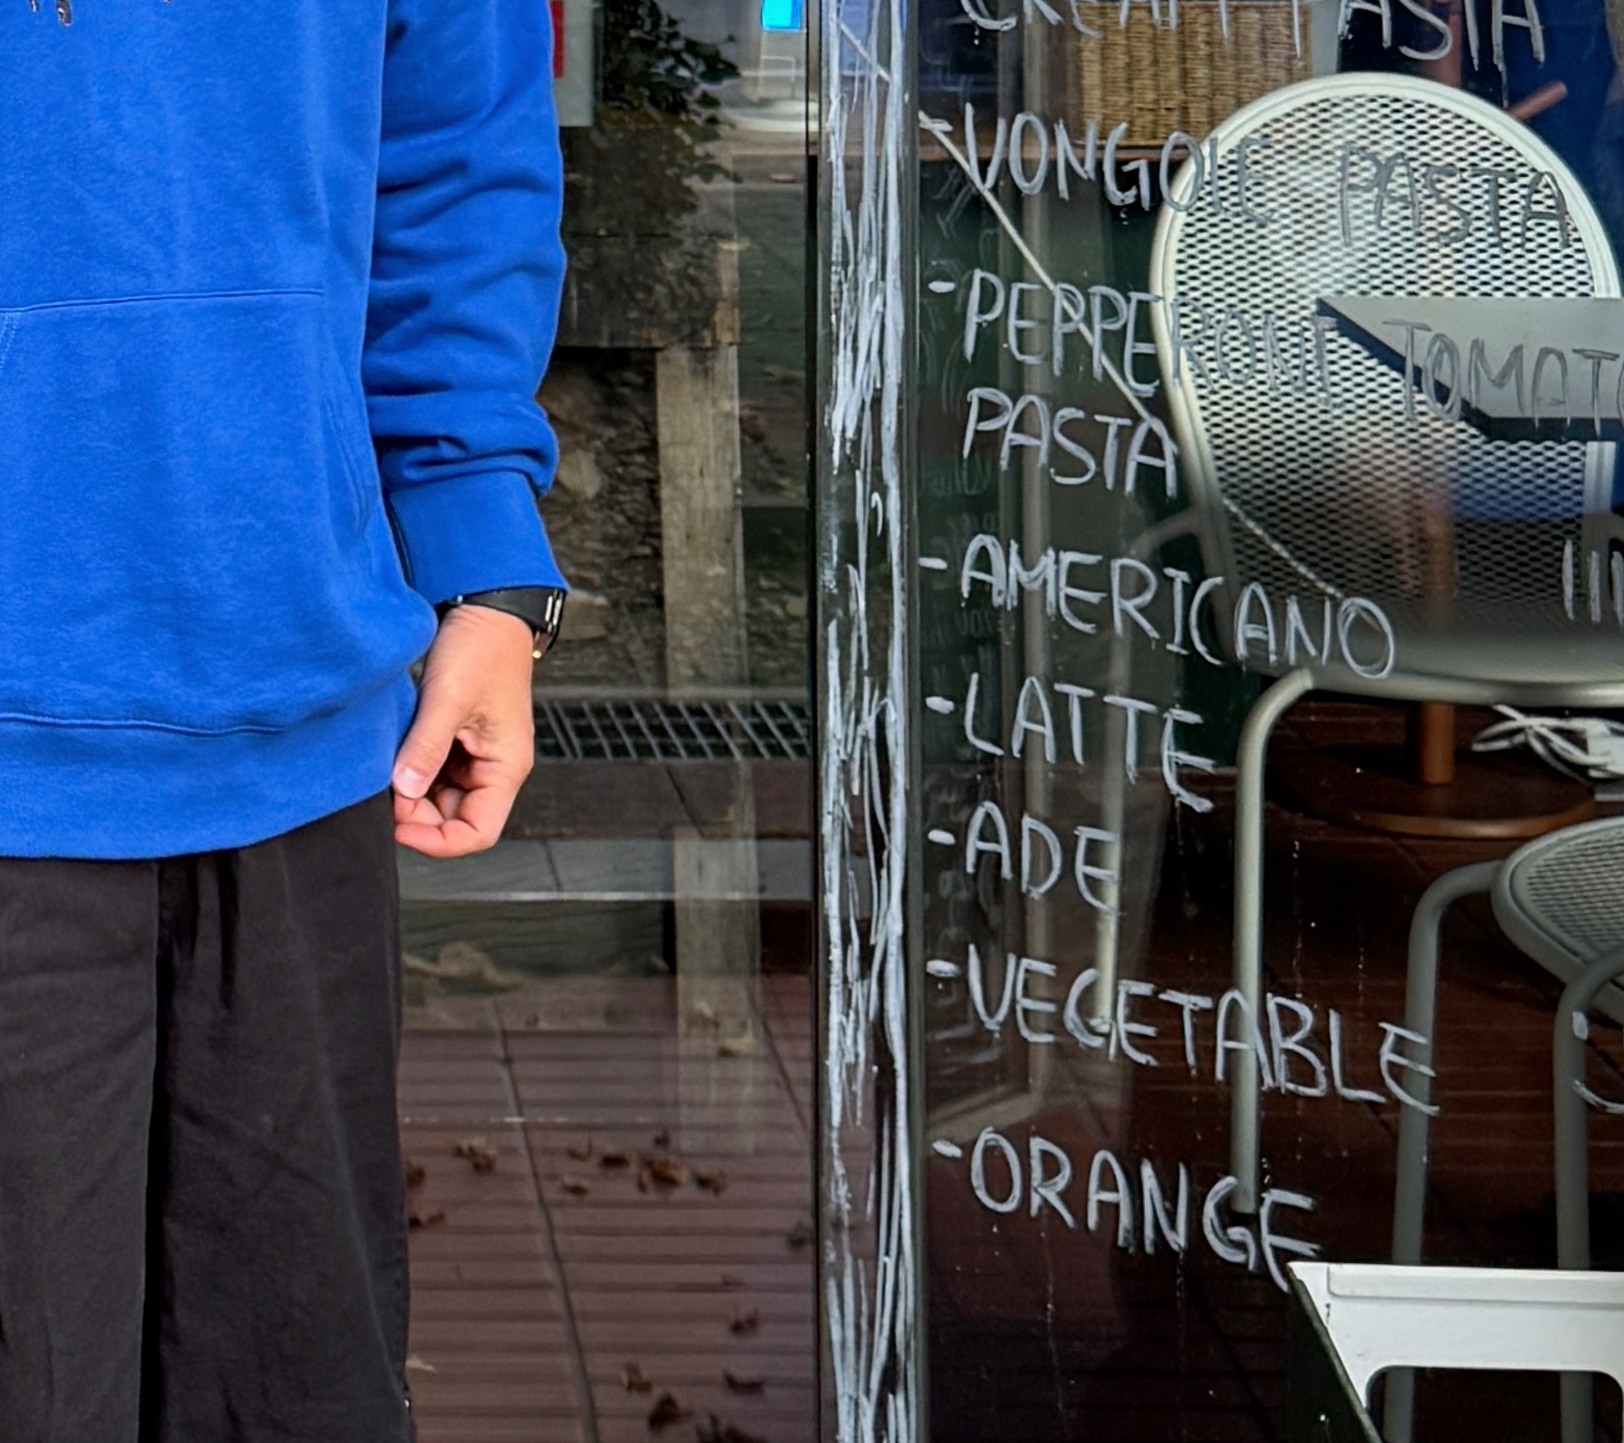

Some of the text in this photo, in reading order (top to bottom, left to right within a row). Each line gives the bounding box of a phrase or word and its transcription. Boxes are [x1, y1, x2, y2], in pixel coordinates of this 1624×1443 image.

[1339, 142, 1574, 251] PASTA
[1383, 320, 1624, 437] TOMAT
[962, 387, 1177, 497] PASTA
